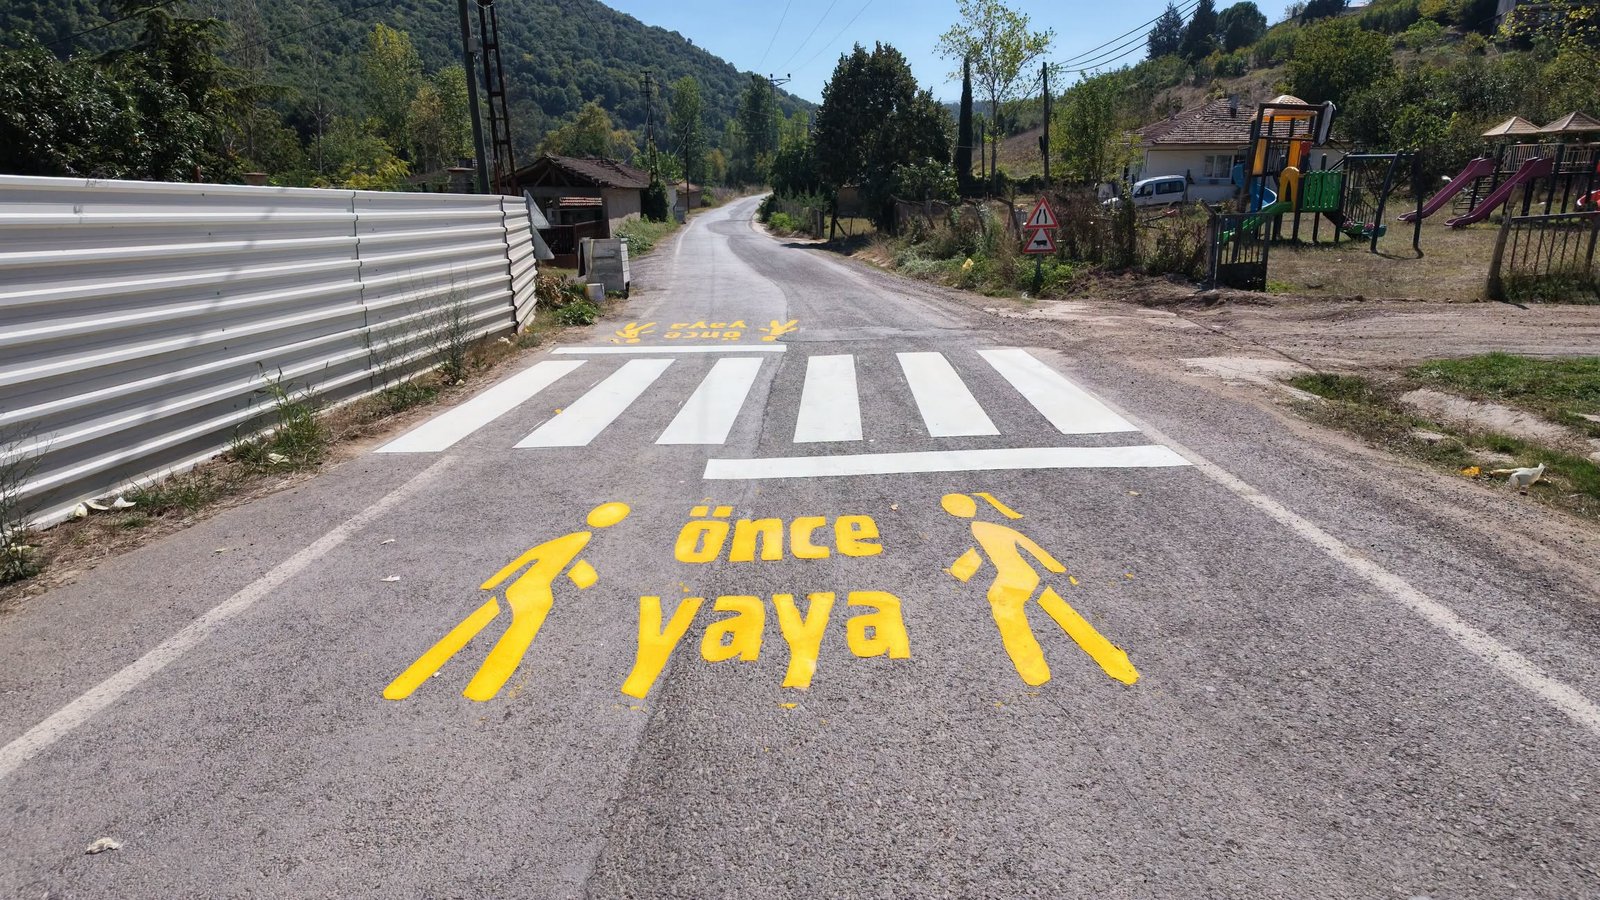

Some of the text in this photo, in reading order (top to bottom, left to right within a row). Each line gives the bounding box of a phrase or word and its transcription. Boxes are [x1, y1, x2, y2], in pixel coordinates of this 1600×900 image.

[665, 331, 741, 340] önce
[670, 320, 747, 329] yaya
[674, 505, 884, 564] önce
[620, 590, 912, 699] yaya
